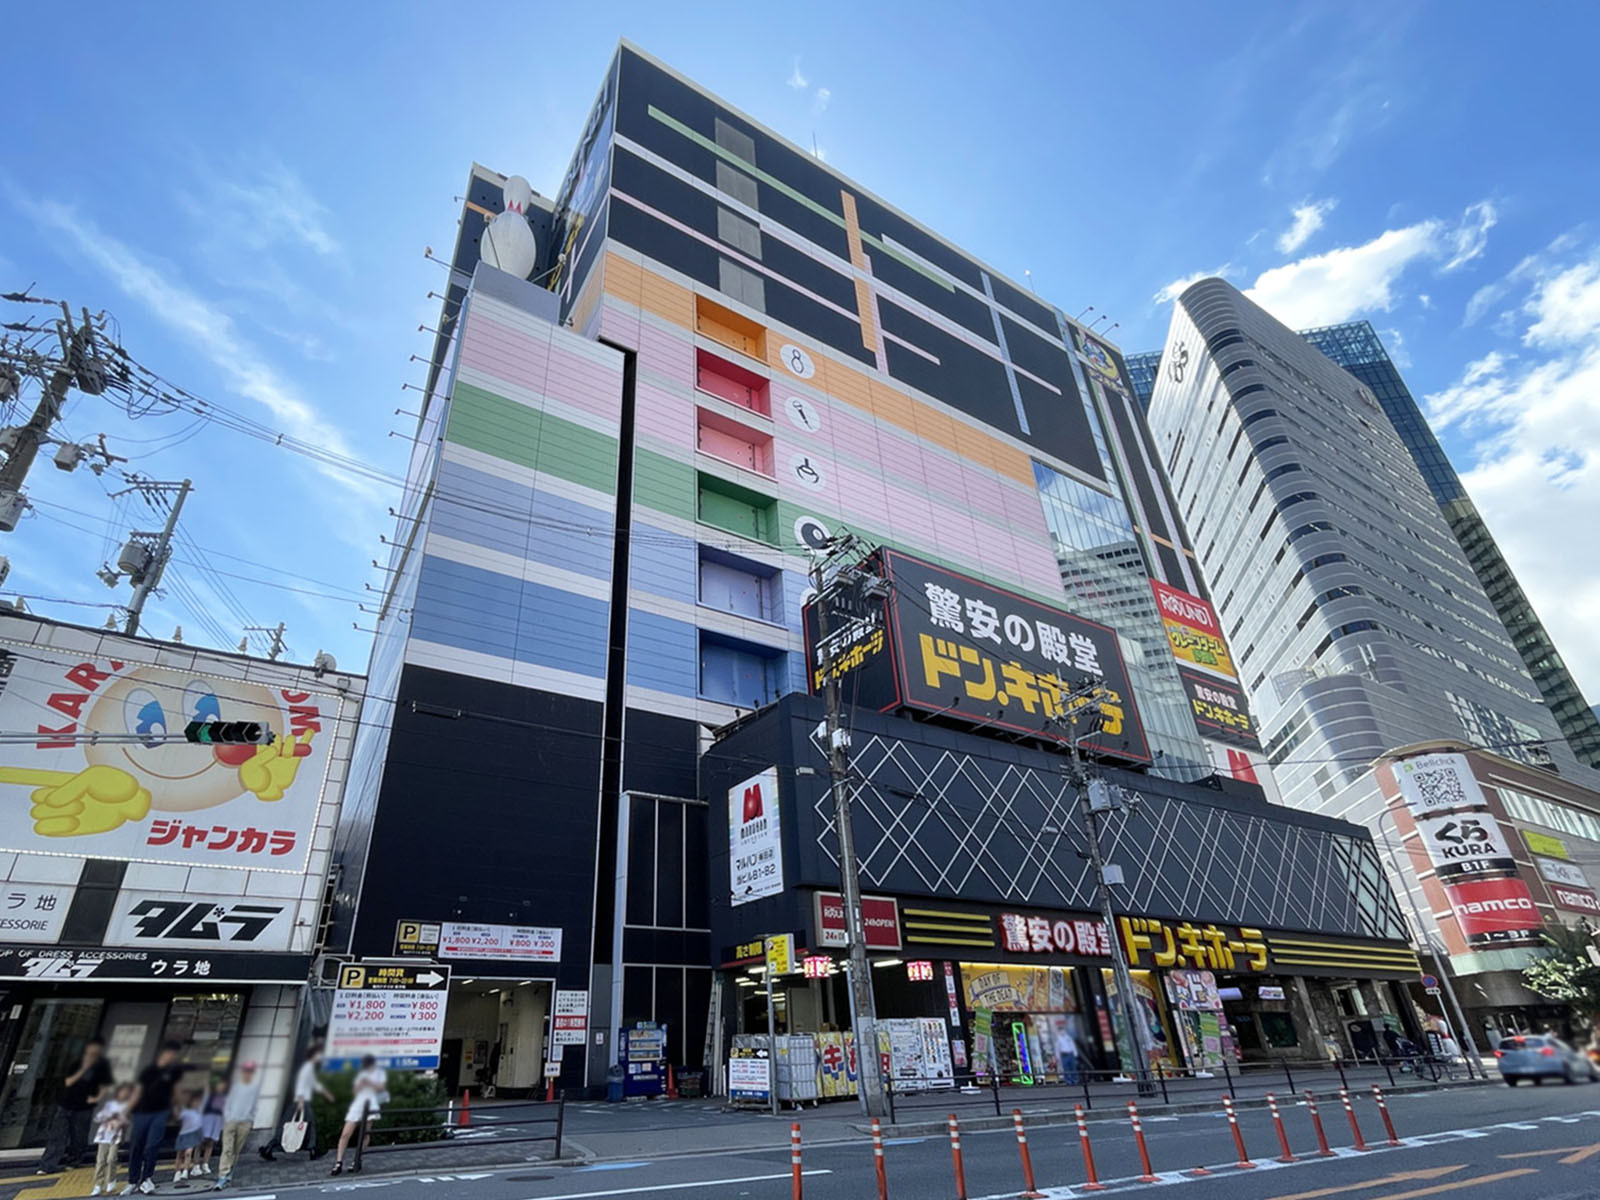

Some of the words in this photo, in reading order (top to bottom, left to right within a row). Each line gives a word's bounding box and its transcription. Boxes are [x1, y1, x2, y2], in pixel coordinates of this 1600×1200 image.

[924, 582, 1104, 676] 驚安の殿堂
[36, 660, 125, 750] KAR
[146, 819, 297, 856] ジャンカラ
[1434, 819, 1489, 845] くら
[1442, 842, 1498, 859] KURA
[1460, 860, 1491, 873] B1F
[1454, 897, 1532, 915] namco
[38, 950, 74, 959] DRESS
[78, 951, 148, 961] ACCESSORIES
[349, 1000, 386, 1010] ¥1,800
[412, 1001, 439, 1011] ¥800
[347, 1011, 385, 1021] ¥2,200
[410, 1012, 438, 1021] ¥300
